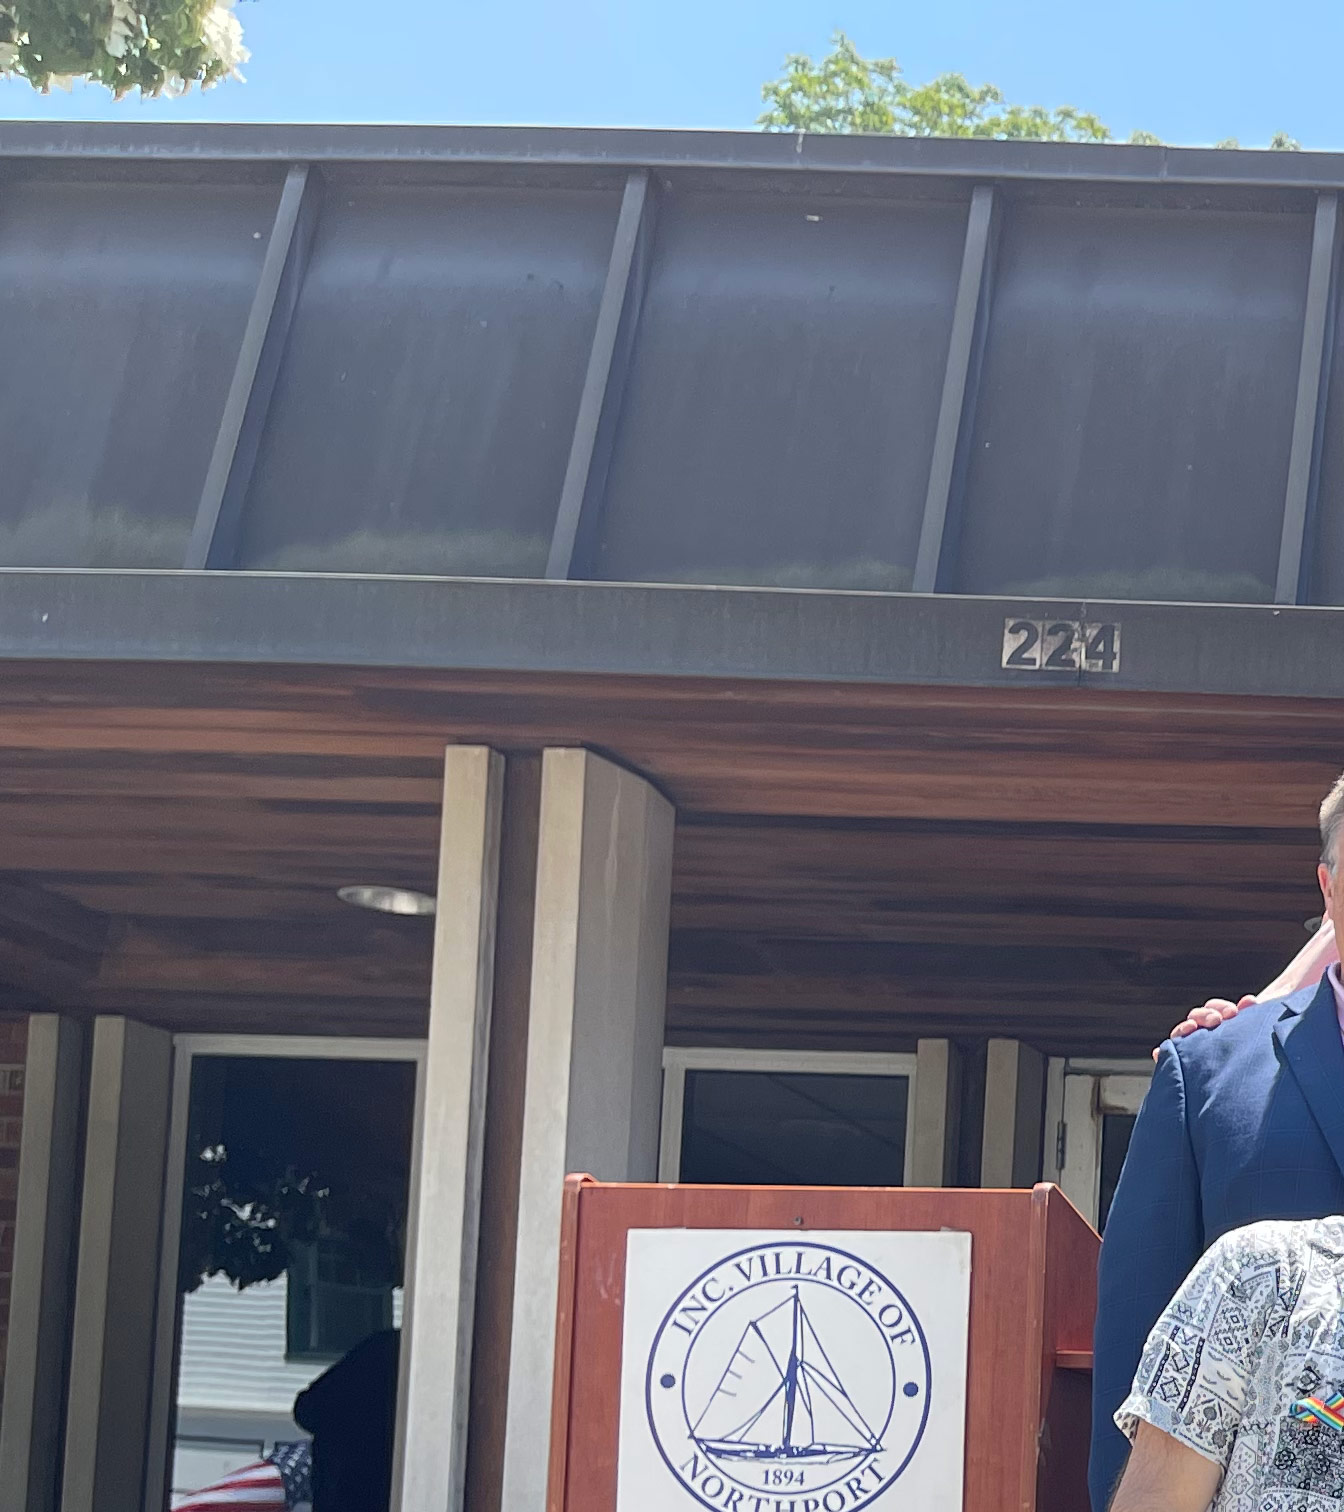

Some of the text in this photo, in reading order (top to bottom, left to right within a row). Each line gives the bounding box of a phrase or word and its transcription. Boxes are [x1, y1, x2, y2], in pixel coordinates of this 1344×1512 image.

[1005, 621, 1117, 671] 224
[671, 1250, 917, 1347] INC. VILLAGE OF
[761, 1468, 806, 1487] 1894
